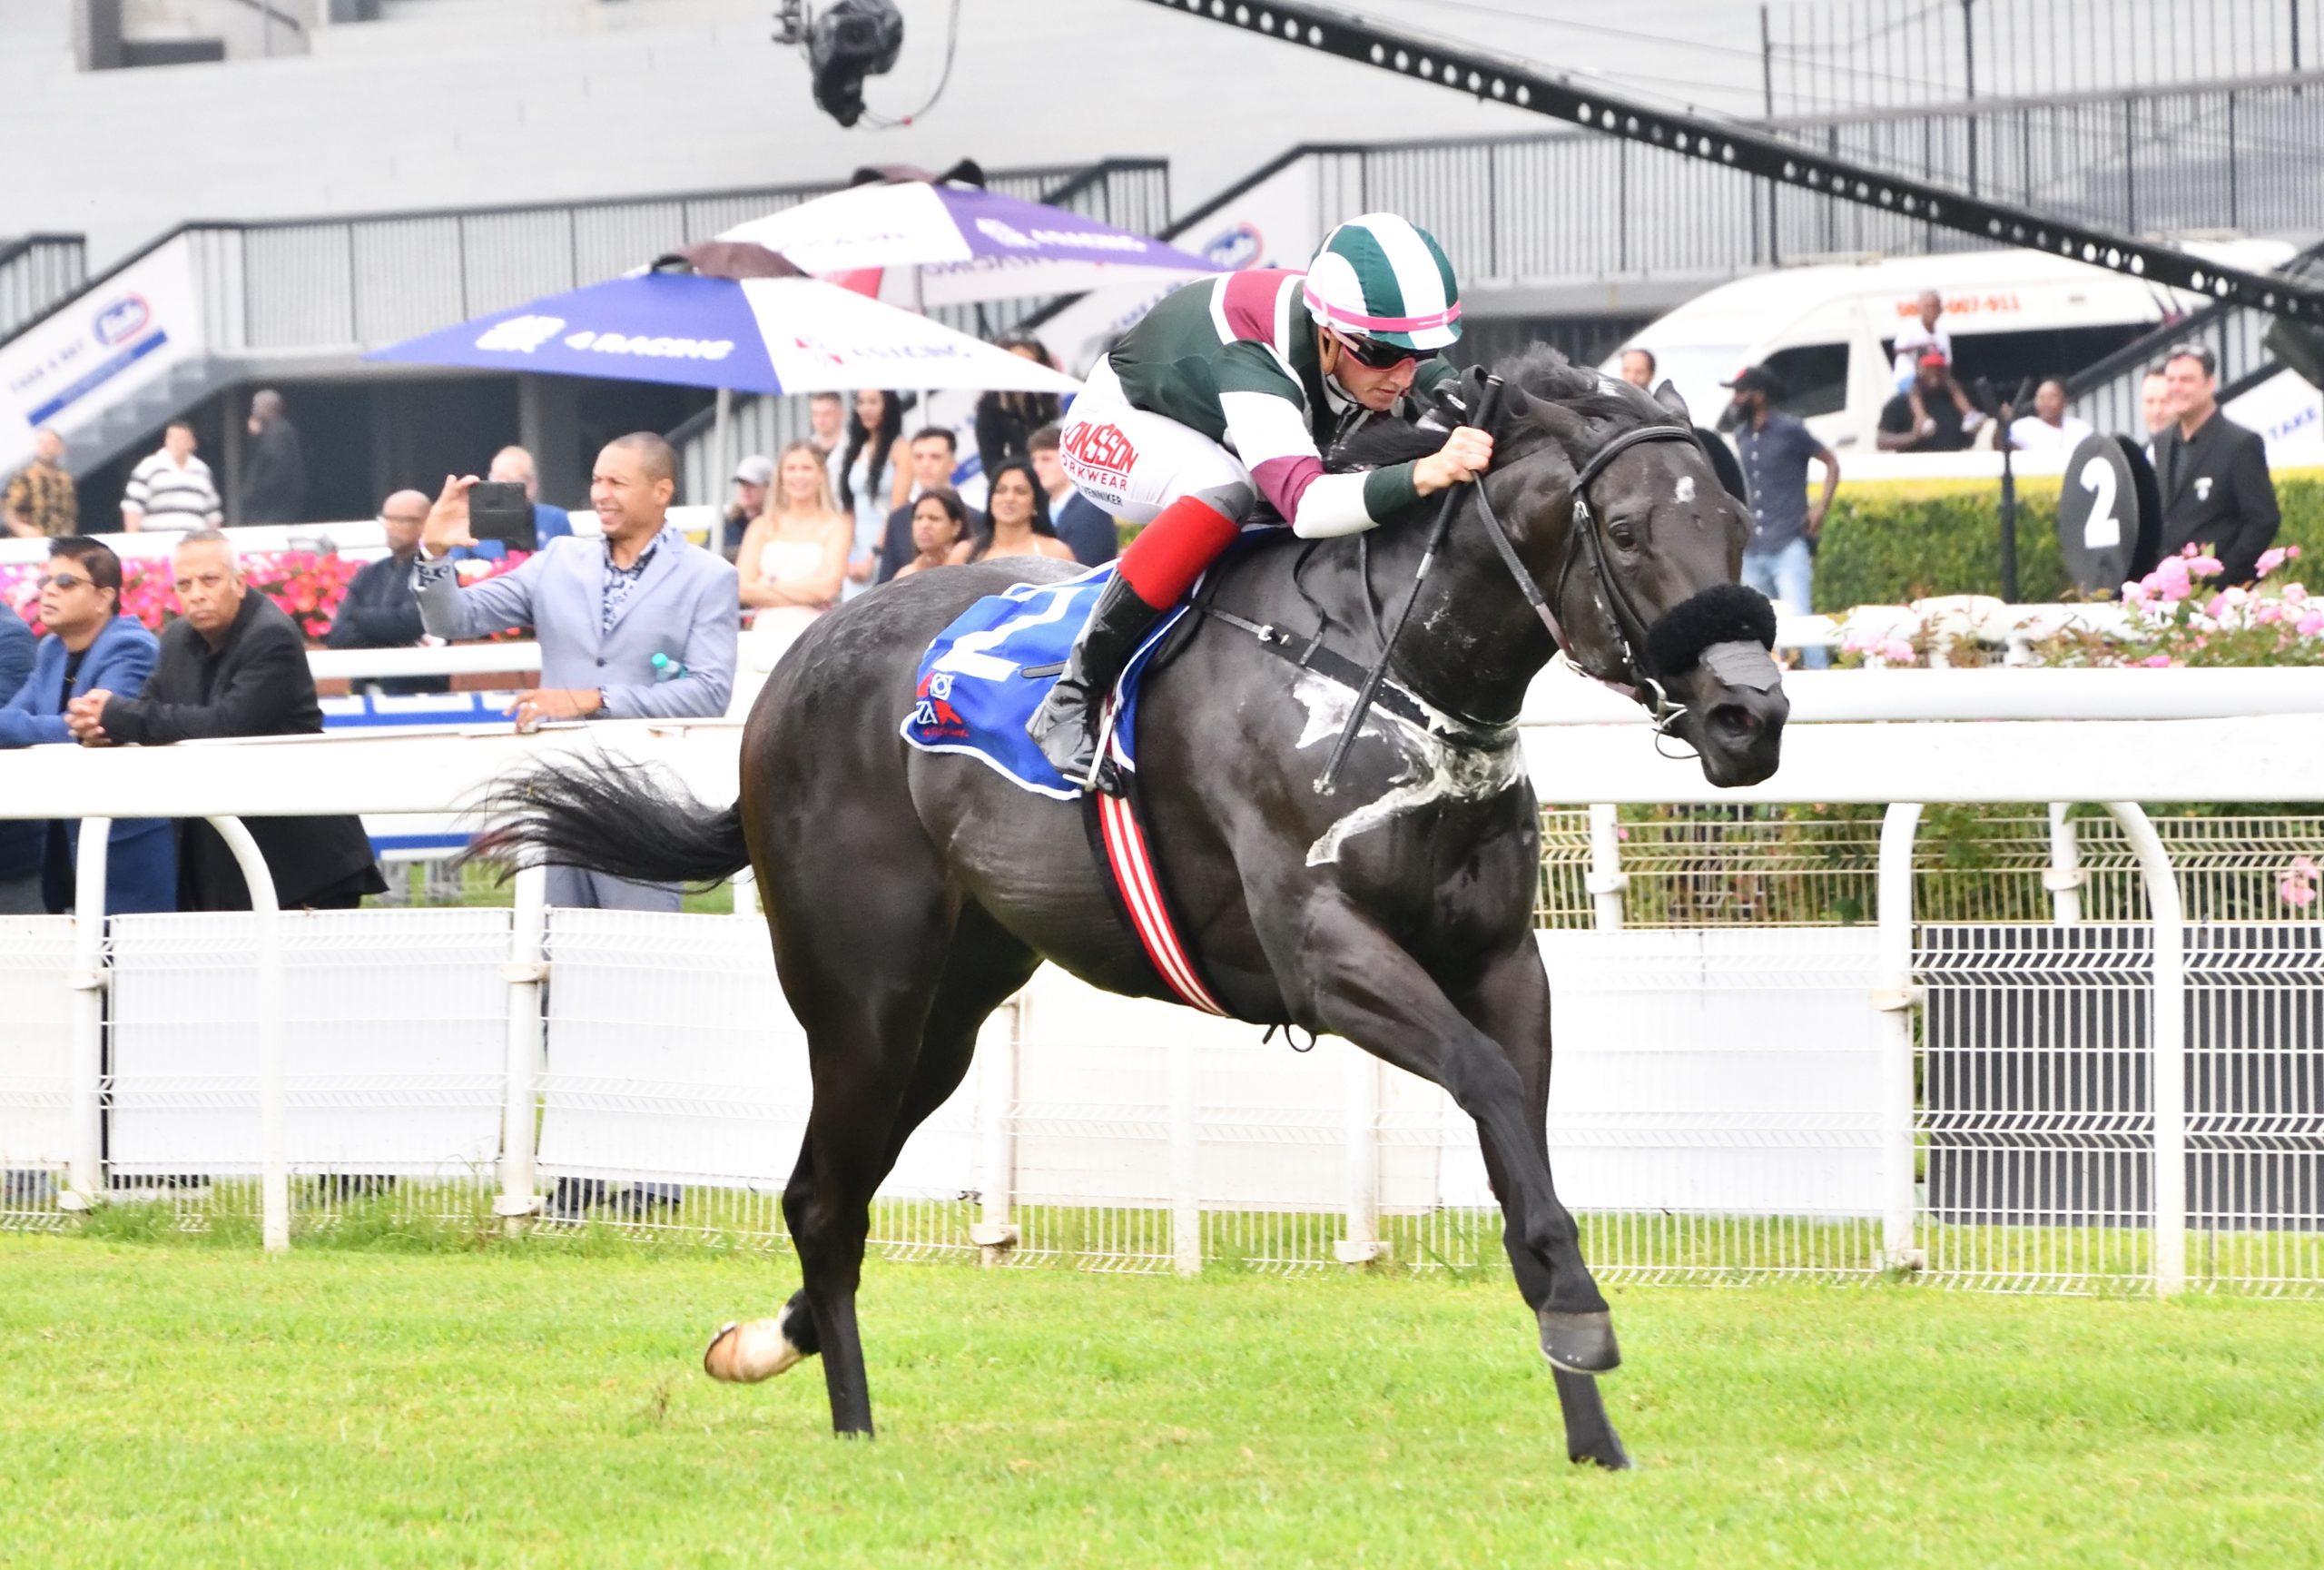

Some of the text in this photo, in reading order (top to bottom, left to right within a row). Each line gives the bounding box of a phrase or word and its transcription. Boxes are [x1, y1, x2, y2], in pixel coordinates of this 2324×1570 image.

[2269, 405, 2317, 441] TAKE
[1062, 454, 1128, 491] ORKWEAR
[2080, 456, 2121, 549] 2
[931, 586, 1087, 683] 2
